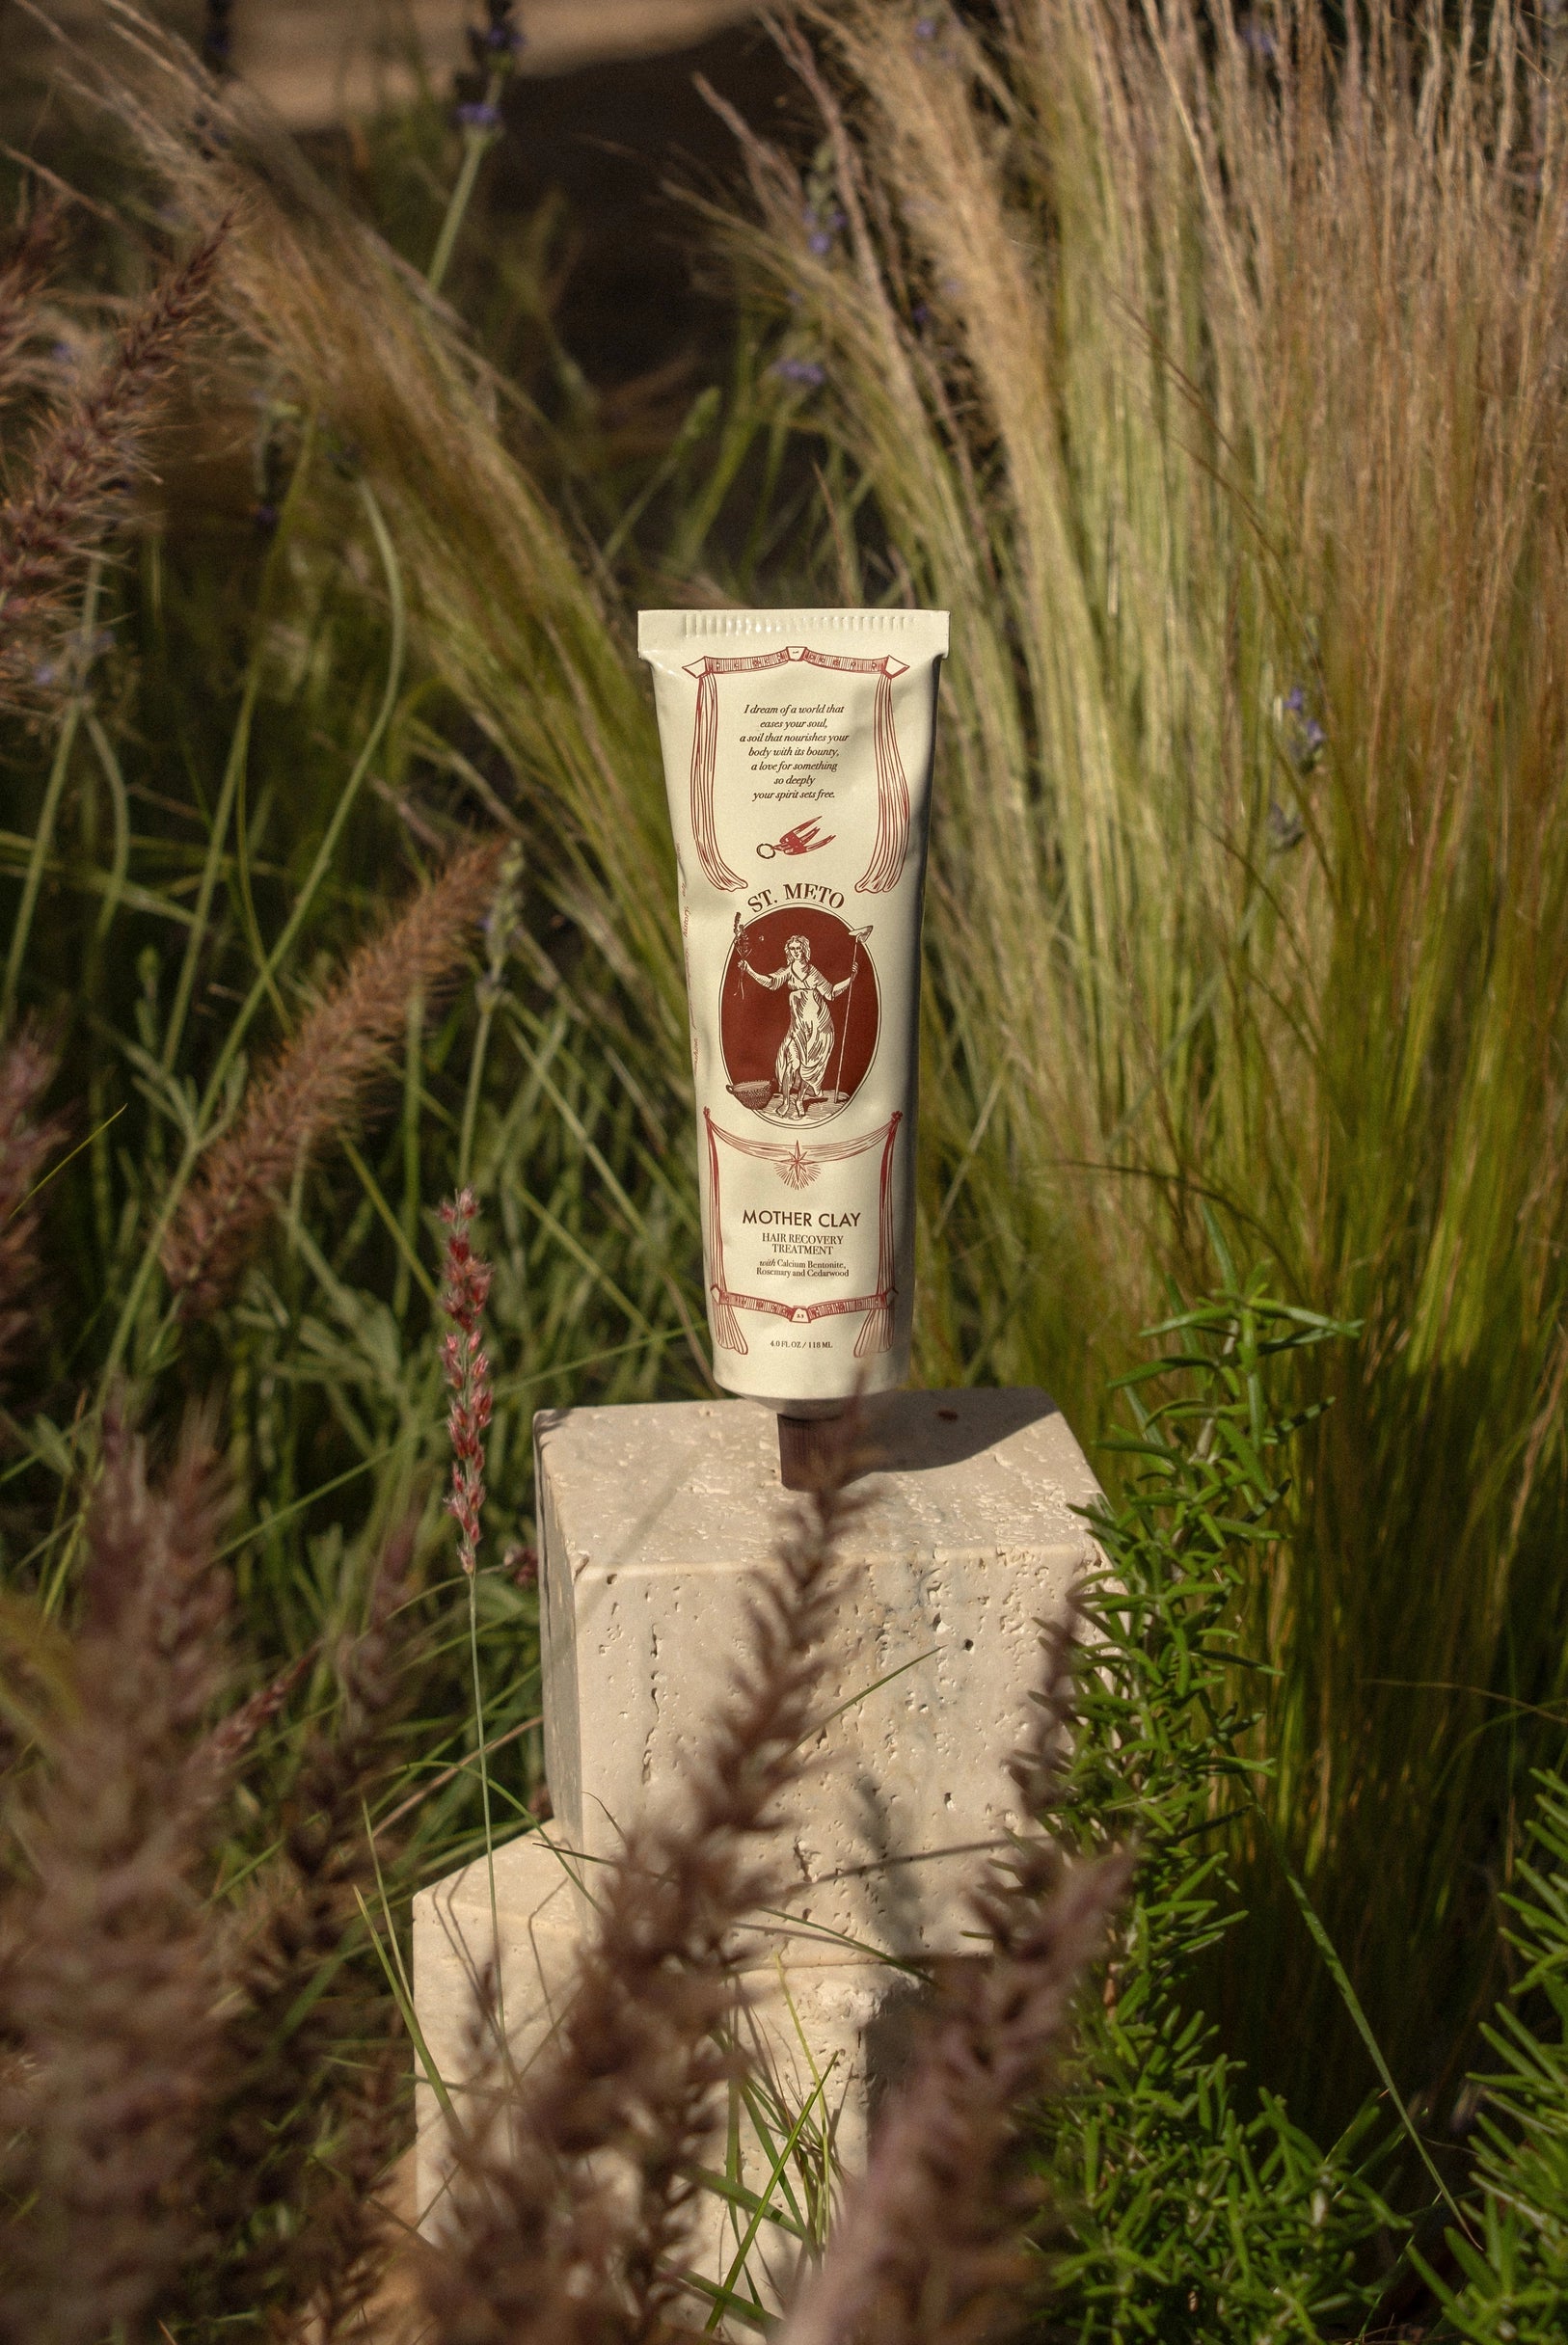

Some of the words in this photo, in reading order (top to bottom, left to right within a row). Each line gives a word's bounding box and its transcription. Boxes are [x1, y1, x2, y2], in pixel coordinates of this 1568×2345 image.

[743, 704, 750, 714] I
[749, 704, 778, 714] dream
[780, 704, 793, 715] of
[798, 704, 825, 714] world
[825, 704, 845, 714] that
[783, 720, 807, 730] your
[806, 718, 828, 729] soul,
[746, 733, 765, 742] soil
[765, 733, 783, 742] that
[784, 732, 827, 742] nourishes
[827, 734, 850, 744] your
[748, 747, 772, 759] body
[773, 747, 793, 756] with
[794, 747, 804, 756] its
[807, 746, 840, 758] bounty,
[759, 761, 777, 770] love
[776, 761, 794, 773] for
[793, 761, 838, 772] something
[785, 775, 816, 787] deeply
[752, 792, 774, 802] your
[775, 790, 799, 801] spirit
[815, 789, 835, 800] free.
[747, 888, 778, 913] ST.
[782, 882, 845, 909] METO
[742, 1209, 813, 1227] MOTHER
[818, 1212, 861, 1227] CLAY
[762, 1232, 787, 1243] HAIR
[789, 1233, 844, 1245] RECOVERY
[771, 1243, 834, 1255] TREATMENT
[777, 1259, 806, 1268] Calcium
[807, 1260, 847, 1270] Bentonite,
[756, 1267, 791, 1279] Rosemary
[807, 1269, 850, 1278] Cedarwood
